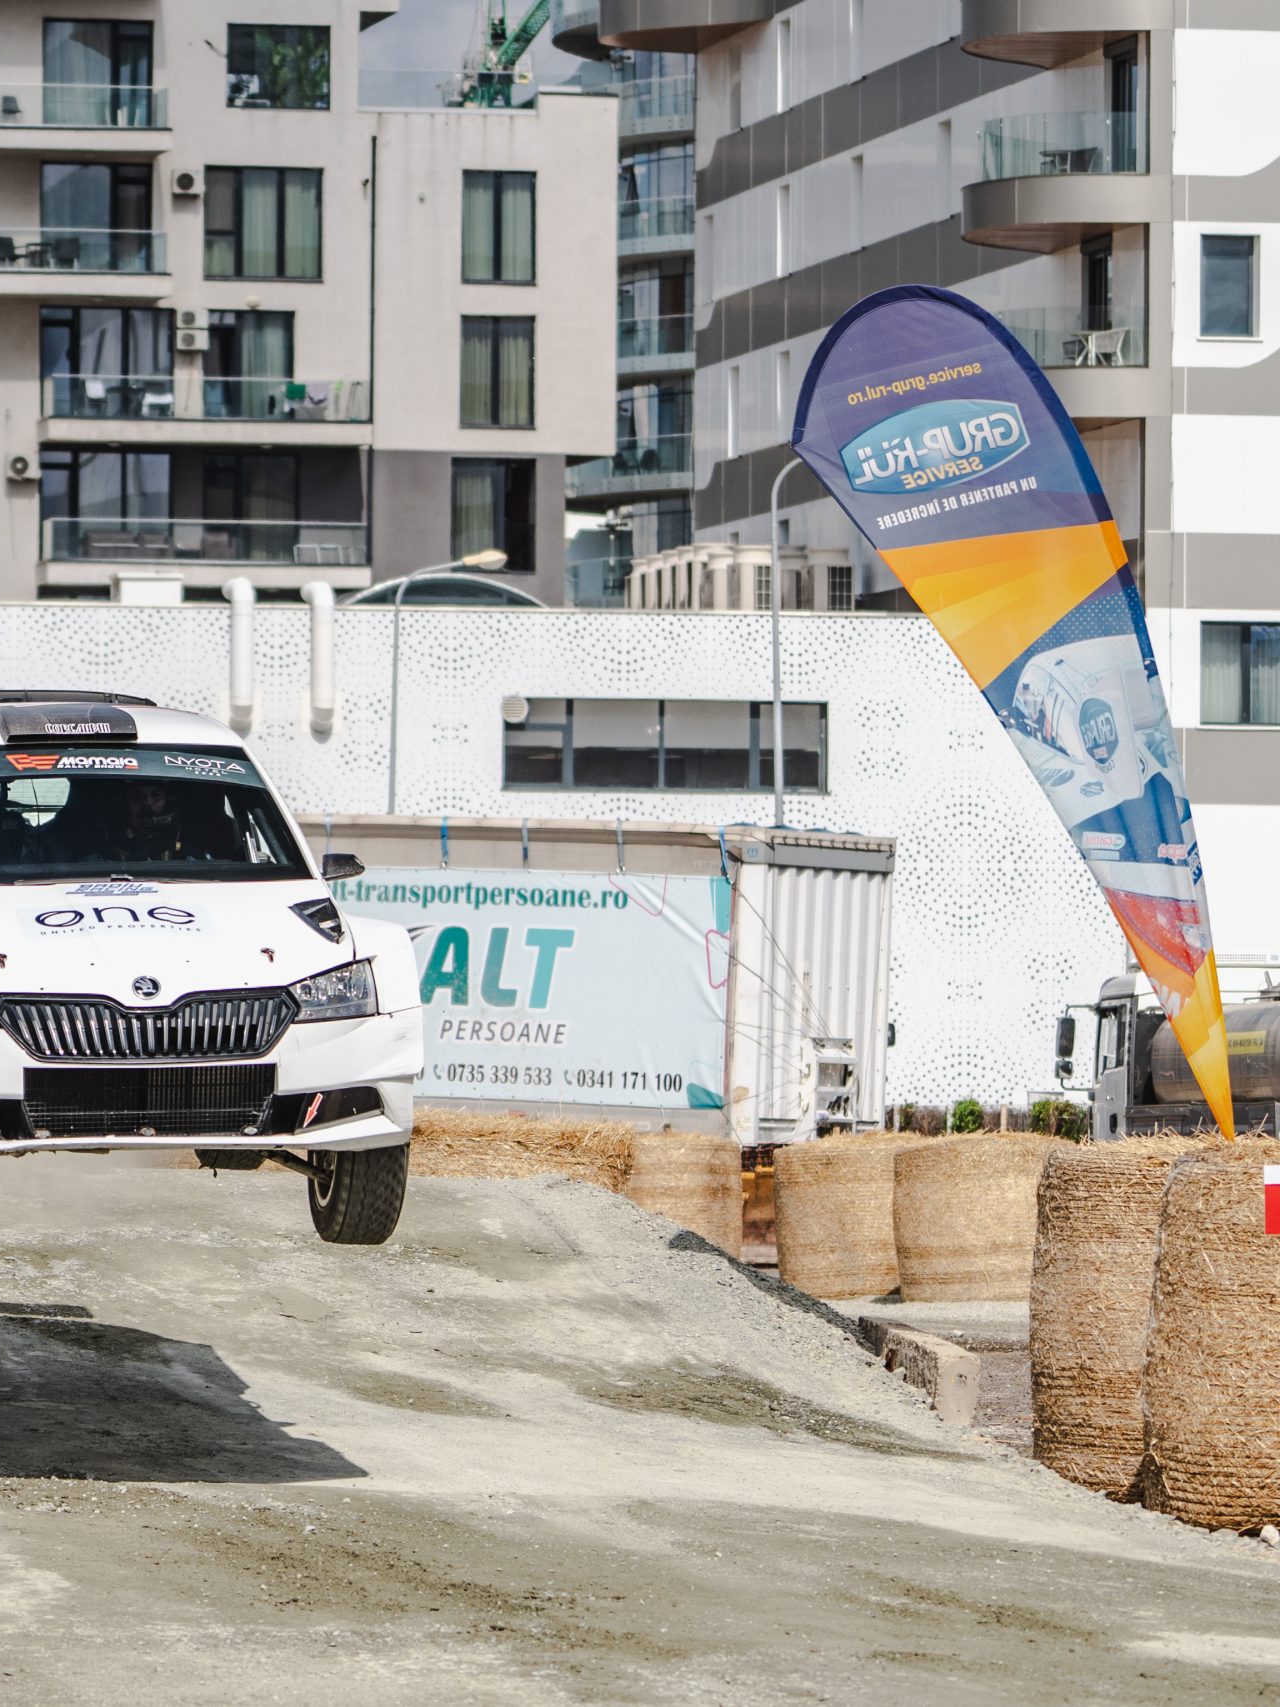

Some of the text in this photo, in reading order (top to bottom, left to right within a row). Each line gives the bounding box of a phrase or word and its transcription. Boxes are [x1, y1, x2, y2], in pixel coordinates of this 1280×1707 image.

[164, 755, 245, 773] NYOTA
[185, 766, 228, 775] HOTEL
[328, 877, 629, 911] lt-transportpersoane.ro
[34, 906, 195, 927] one
[40, 924, 201, 935] UNITED PROPERTIES
[420, 926, 574, 1009] ALT
[439, 1020, 567, 1045] PERSOANE
[447, 1064, 484, 1083] 0735
[490, 1065, 518, 1084] 339
[523, 1067, 552, 1086] 533
[577, 1069, 614, 1088] 0341
[621, 1071, 647, 1090] 171
[655, 1073, 682, 1092] 100
